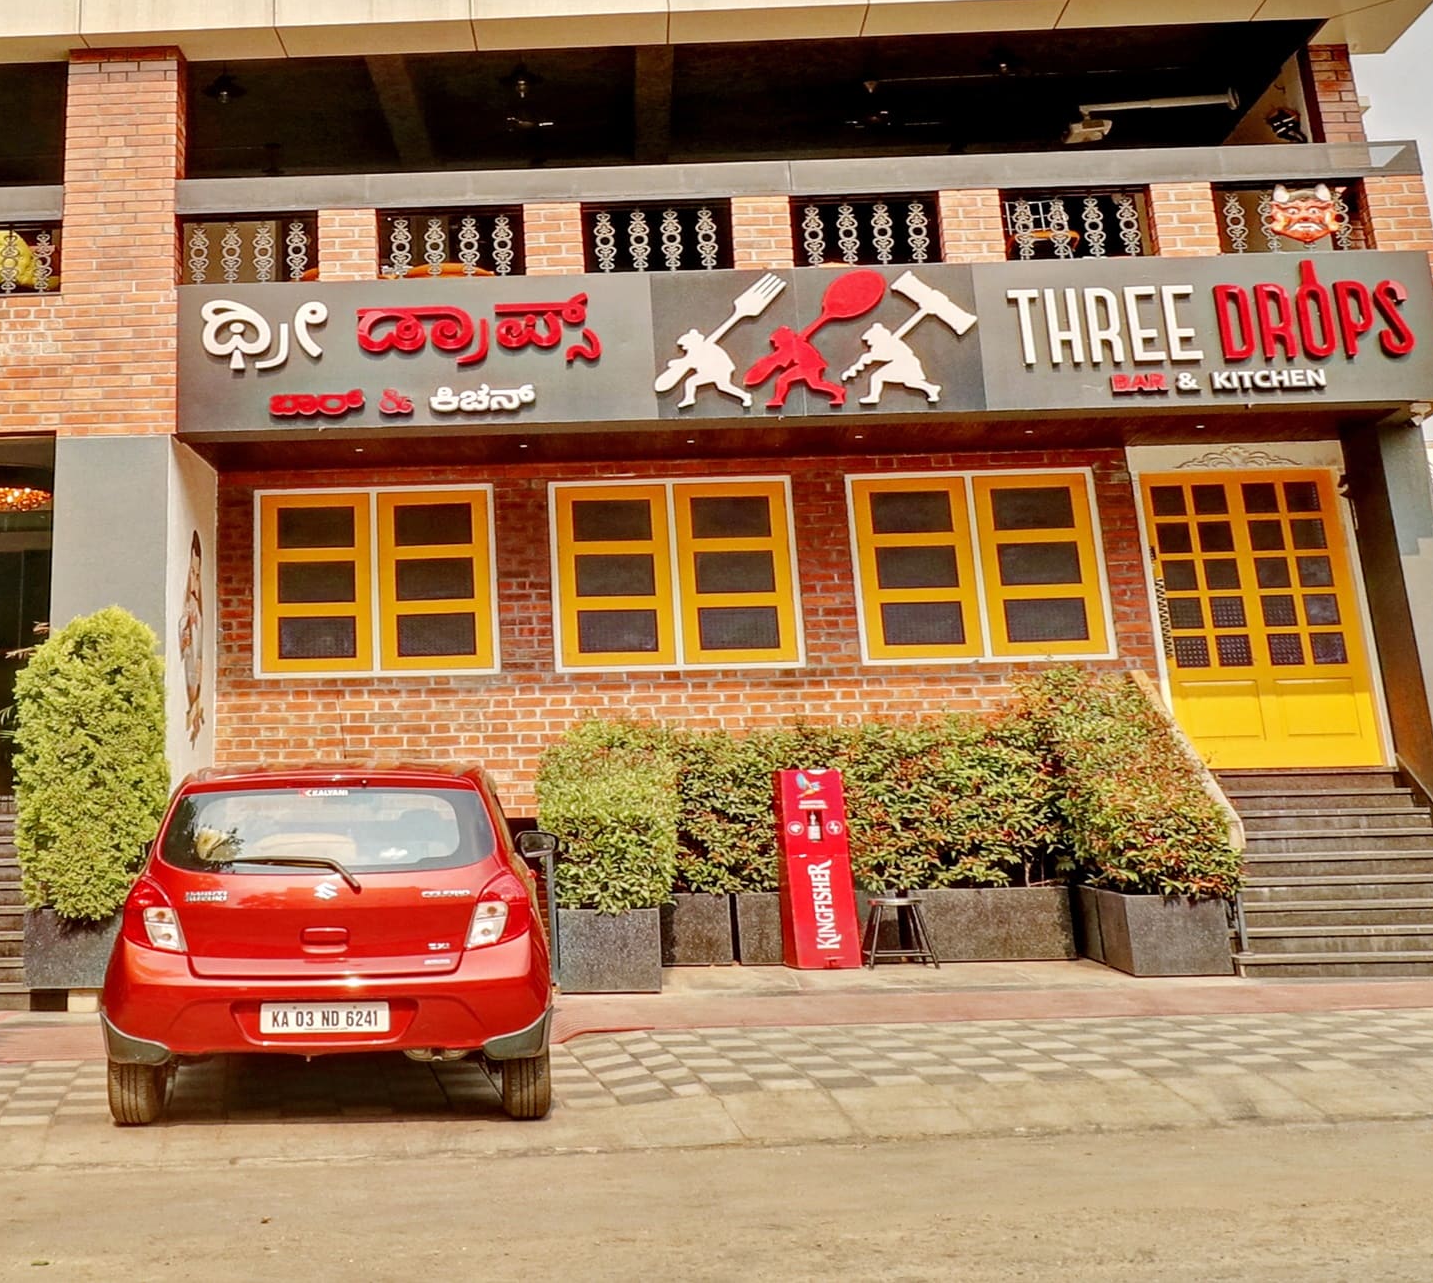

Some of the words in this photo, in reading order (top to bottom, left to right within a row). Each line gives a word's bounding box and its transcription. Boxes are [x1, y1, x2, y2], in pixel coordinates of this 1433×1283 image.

[1006, 284, 1205, 366] THREE
[1213, 260, 1416, 360] DROPS
[1111, 373, 1169, 394] BAR
[1176, 372, 1203, 392] &
[1212, 368, 1328, 392] KITCHEN
[807, 859, 842, 949] KINGFISHER
[272, 1011, 289, 1027] KA
[296, 1011, 314, 1027] 03
[322, 1010, 340, 1026] ND
[346, 1010, 378, 1026] 6241
